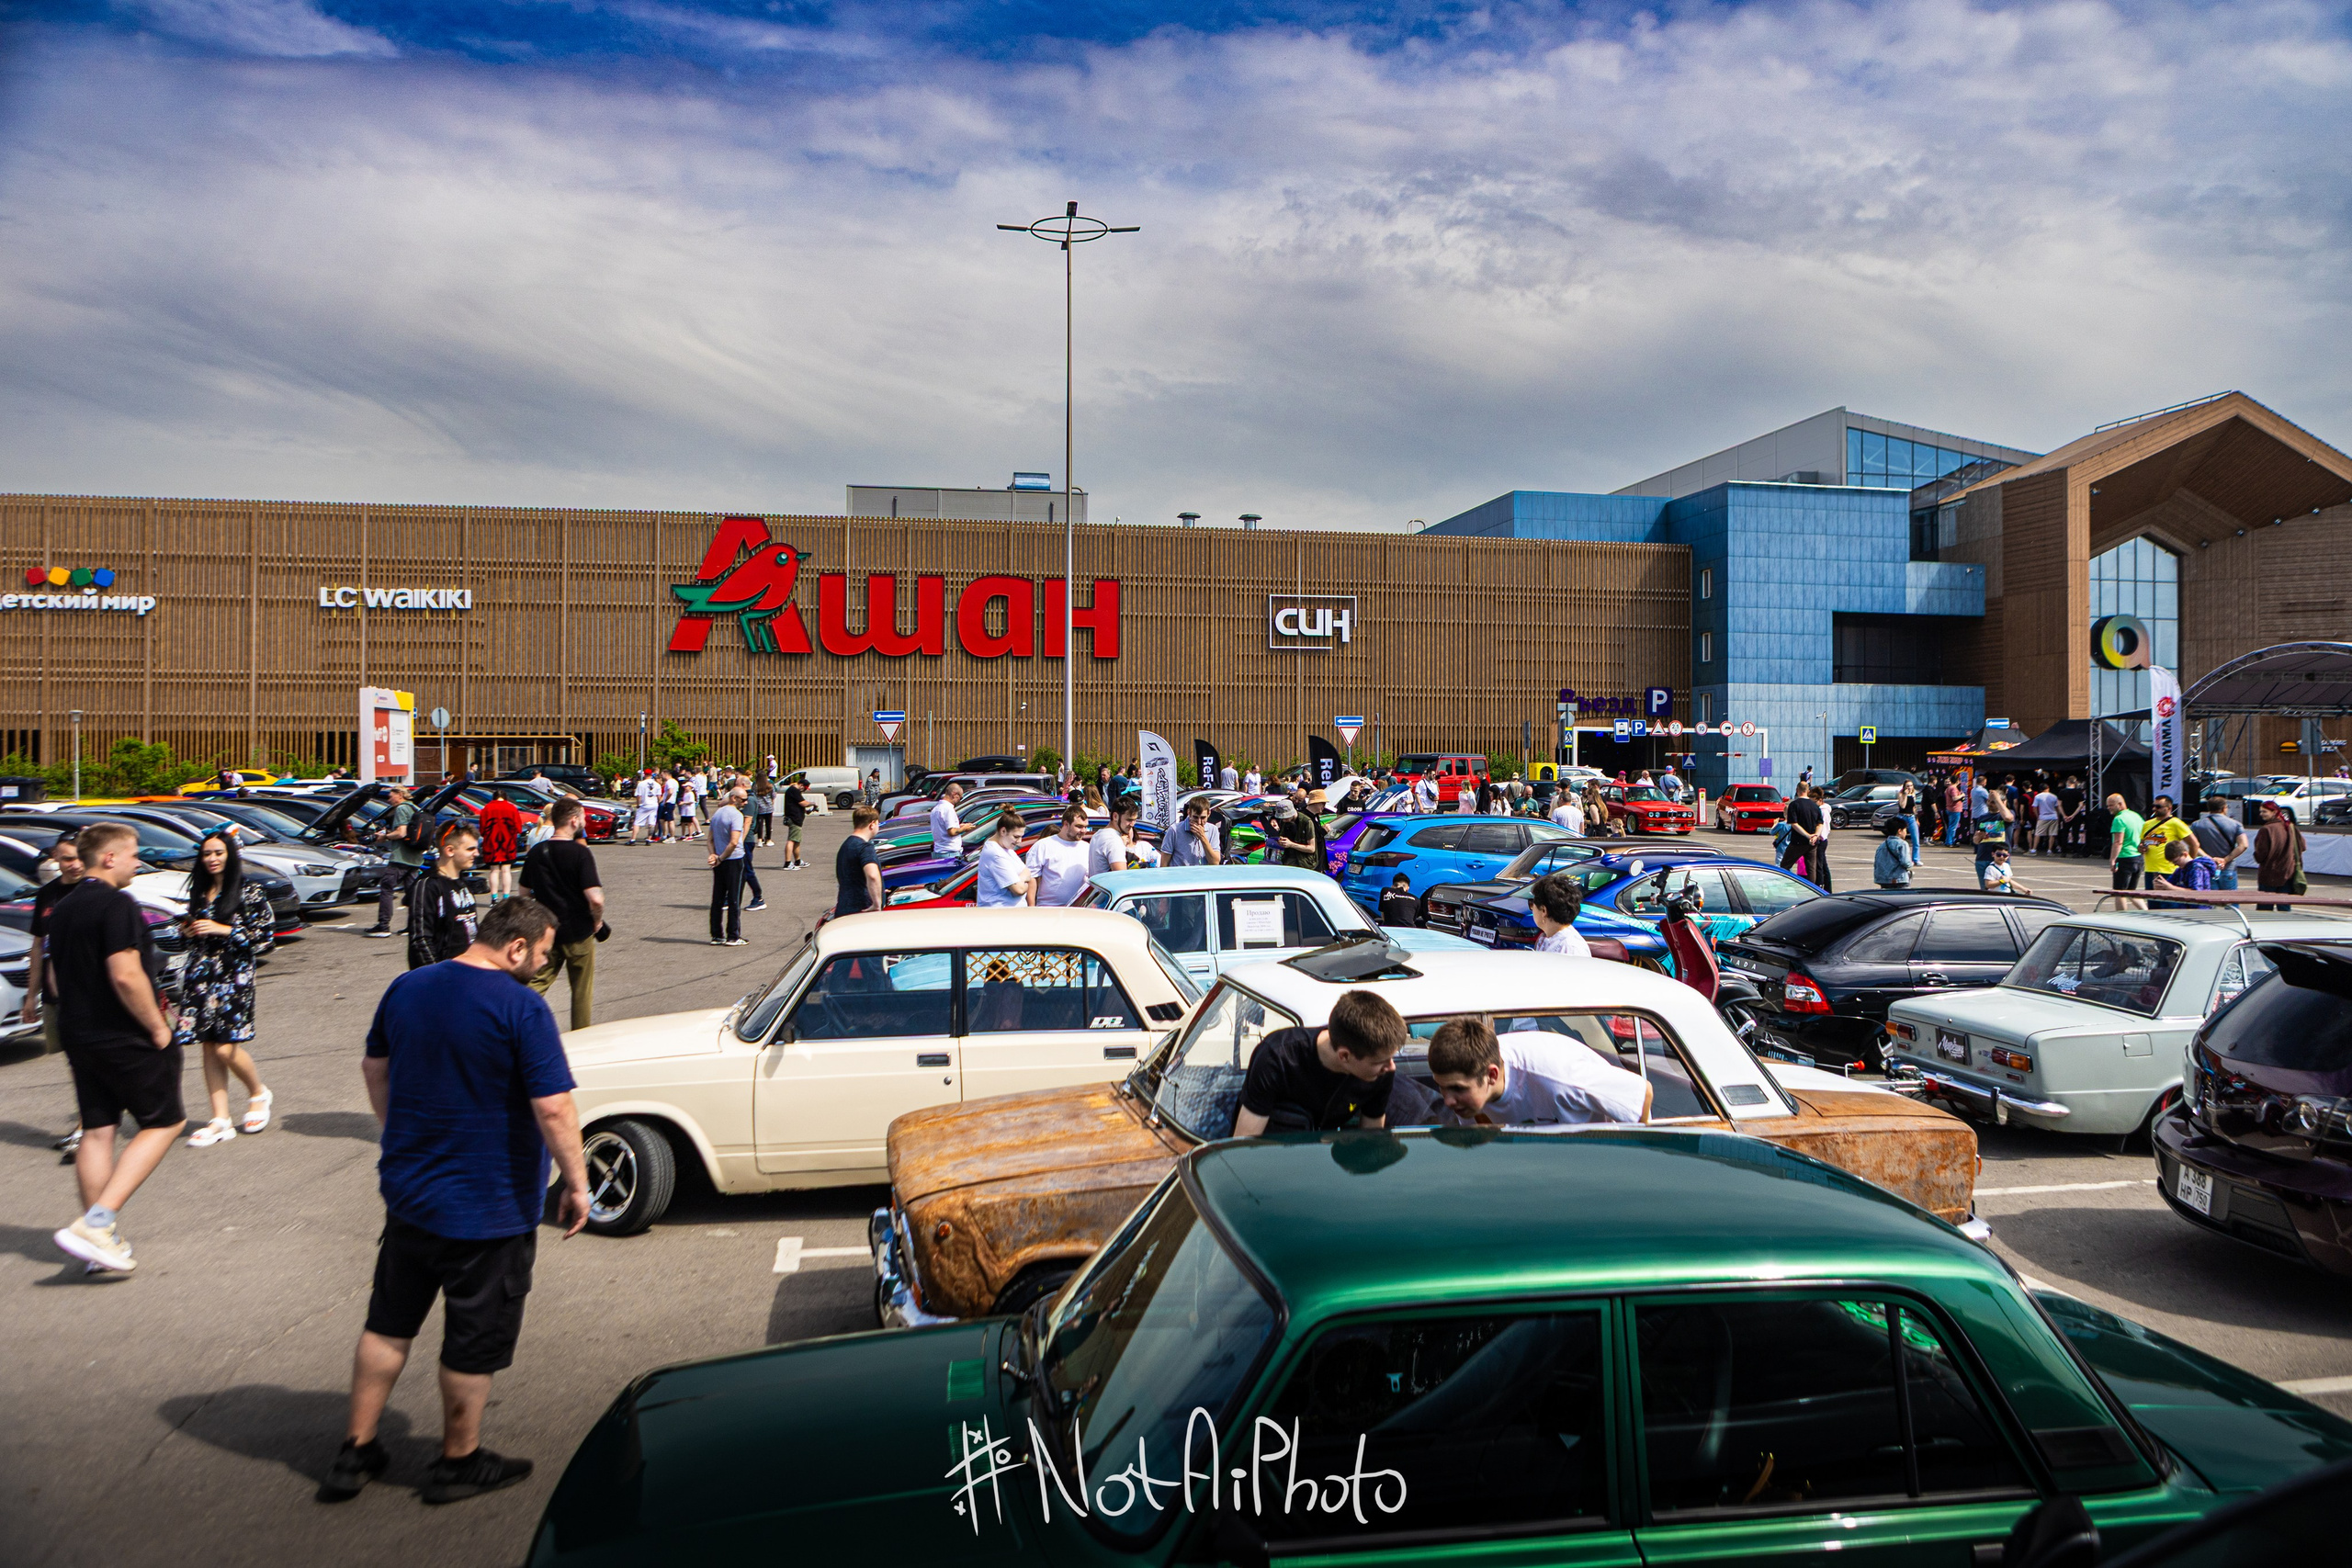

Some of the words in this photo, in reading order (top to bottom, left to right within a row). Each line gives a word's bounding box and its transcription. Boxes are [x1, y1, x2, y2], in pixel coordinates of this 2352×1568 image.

[0, 588, 98, 610] етский
[101, 595, 156, 615] мир
[320, 587, 357, 608] LC
[1560, 688, 1637, 716] Въезд
[2160, 718, 2173, 791] TAKAYAMA
